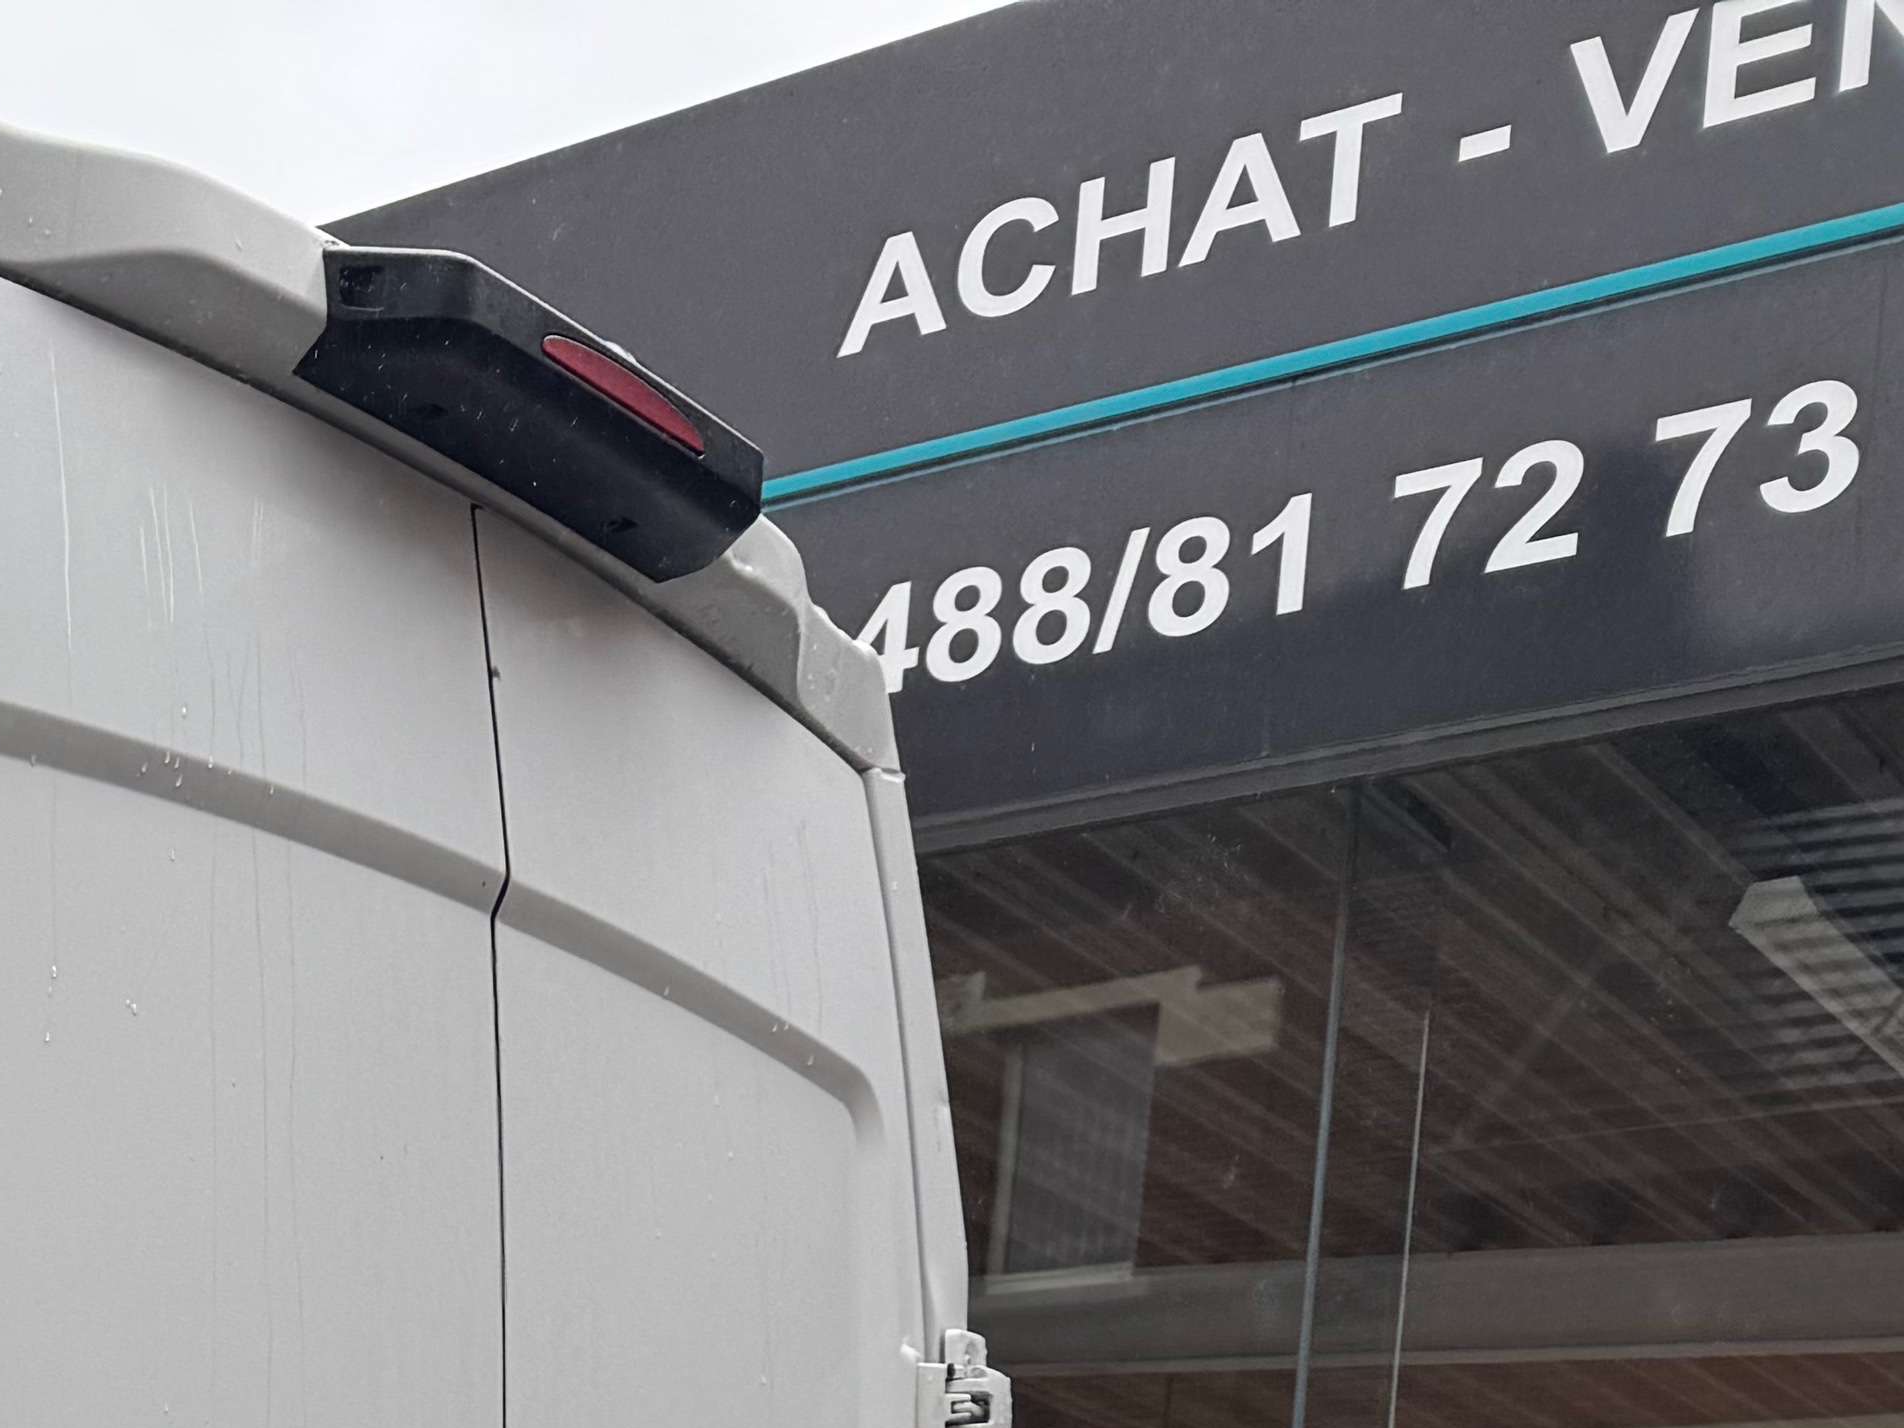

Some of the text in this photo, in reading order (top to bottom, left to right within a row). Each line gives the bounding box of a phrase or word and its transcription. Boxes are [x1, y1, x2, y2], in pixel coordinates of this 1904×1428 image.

[836, 92, 1404, 358] ACHAT
[1458, 124, 1512, 162] -
[1393, 438, 1586, 590] 72
[1653, 379, 1860, 539] 73
